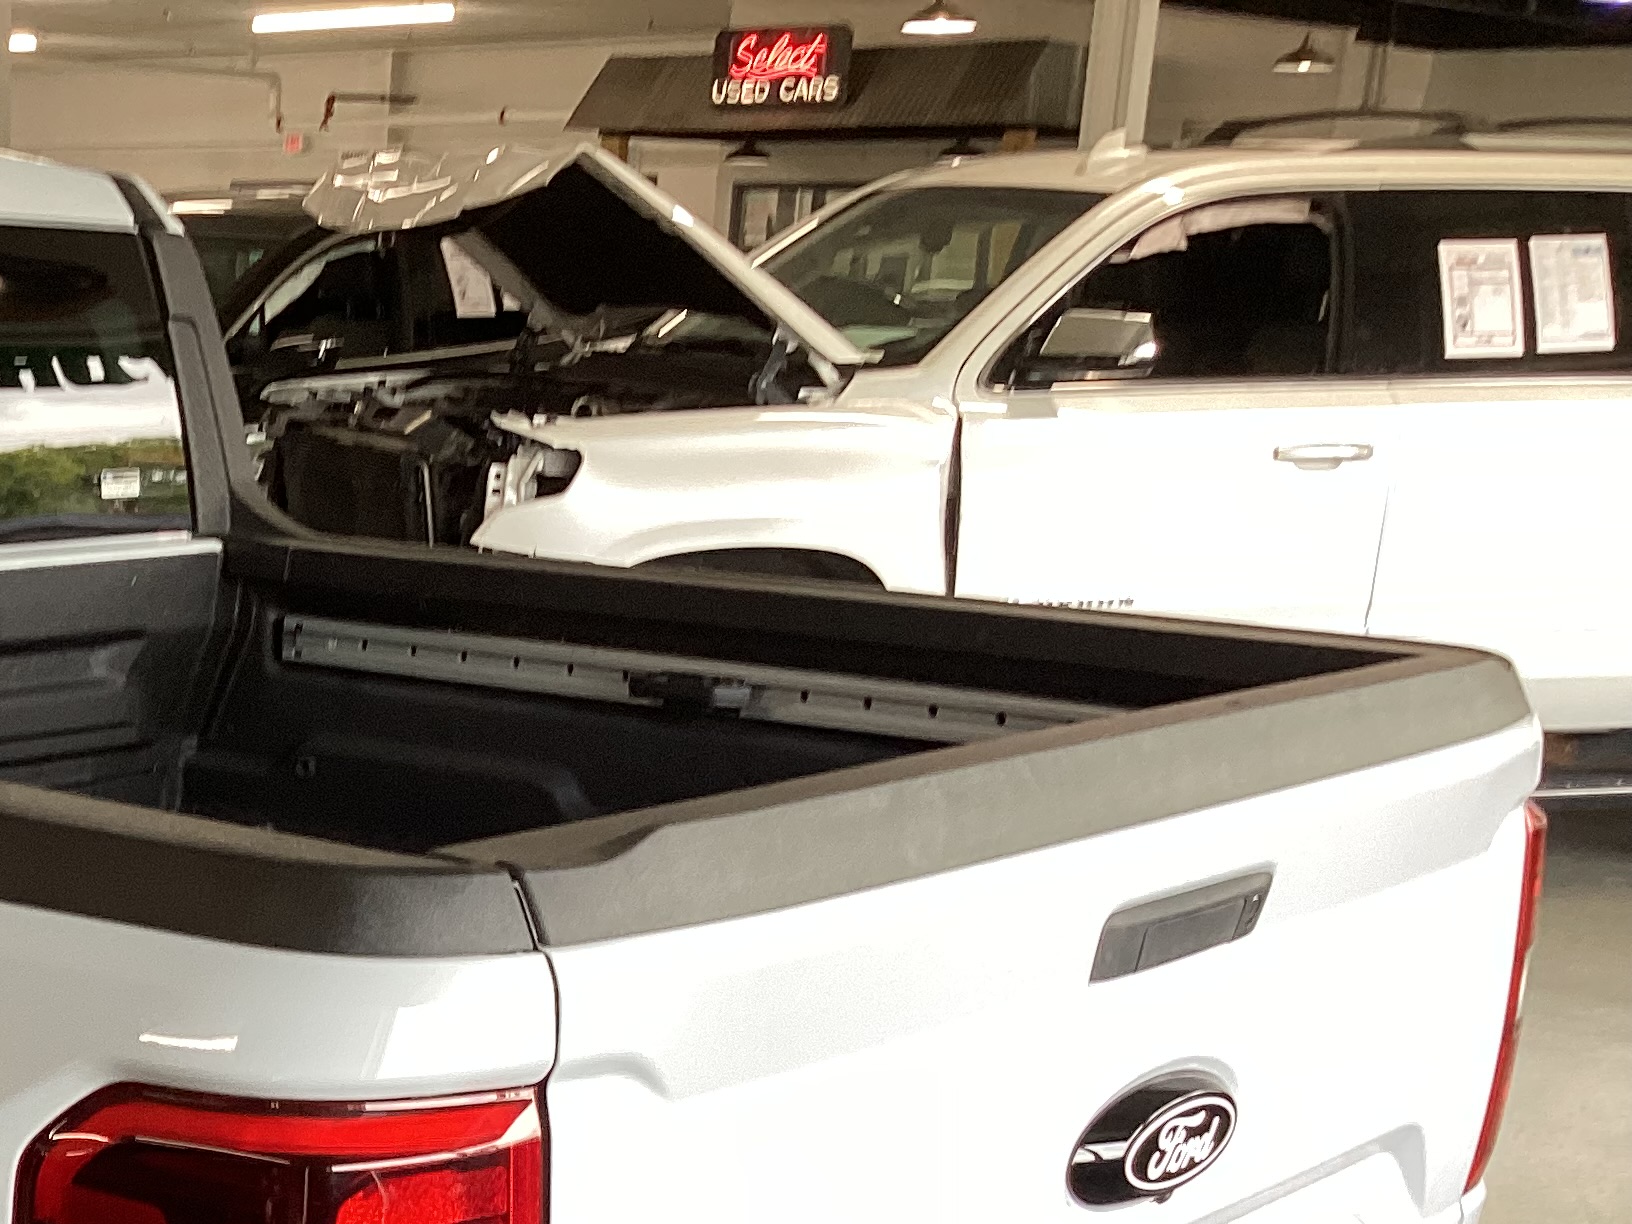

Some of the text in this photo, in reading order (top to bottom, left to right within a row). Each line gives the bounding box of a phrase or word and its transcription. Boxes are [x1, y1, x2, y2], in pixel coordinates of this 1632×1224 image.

[730, 32, 826, 78] Select
[711, 74, 840, 104] USED CARS
[1147, 1110, 1220, 1180] Ford
